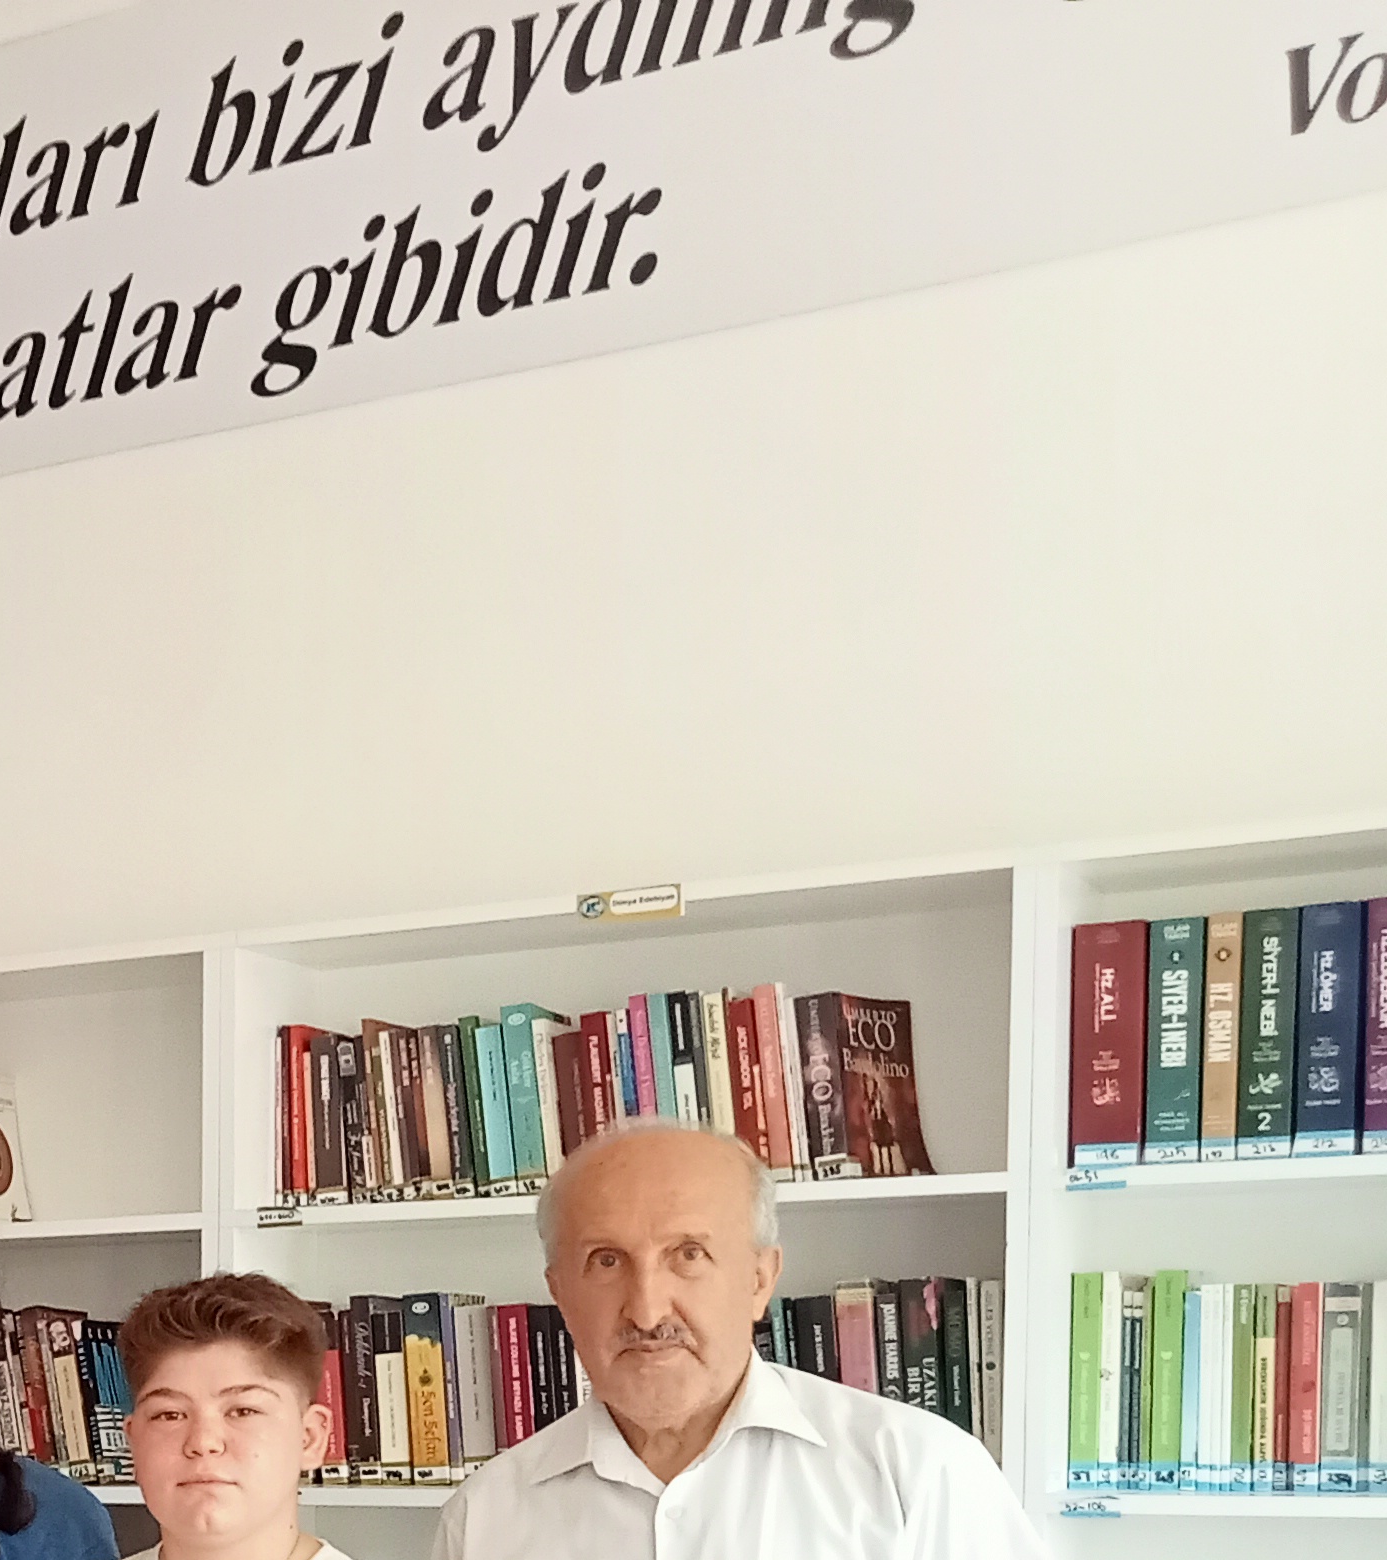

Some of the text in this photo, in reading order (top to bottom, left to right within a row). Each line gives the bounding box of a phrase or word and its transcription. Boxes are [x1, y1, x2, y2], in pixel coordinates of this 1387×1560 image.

[185, 10, 406, 188] bizi
[249, 161, 665, 399] gibidir.
[847, 1017, 896, 1052] ECO
[1207, 981, 1233, 1063] HZ. OSMAN
[1258, 998, 1279, 1038] NEBİ
[809, 1053, 833, 1101] ECO
[1256, 1111, 1272, 1132] 2
[879, 1302, 900, 1380] JOANNE HARRIS
